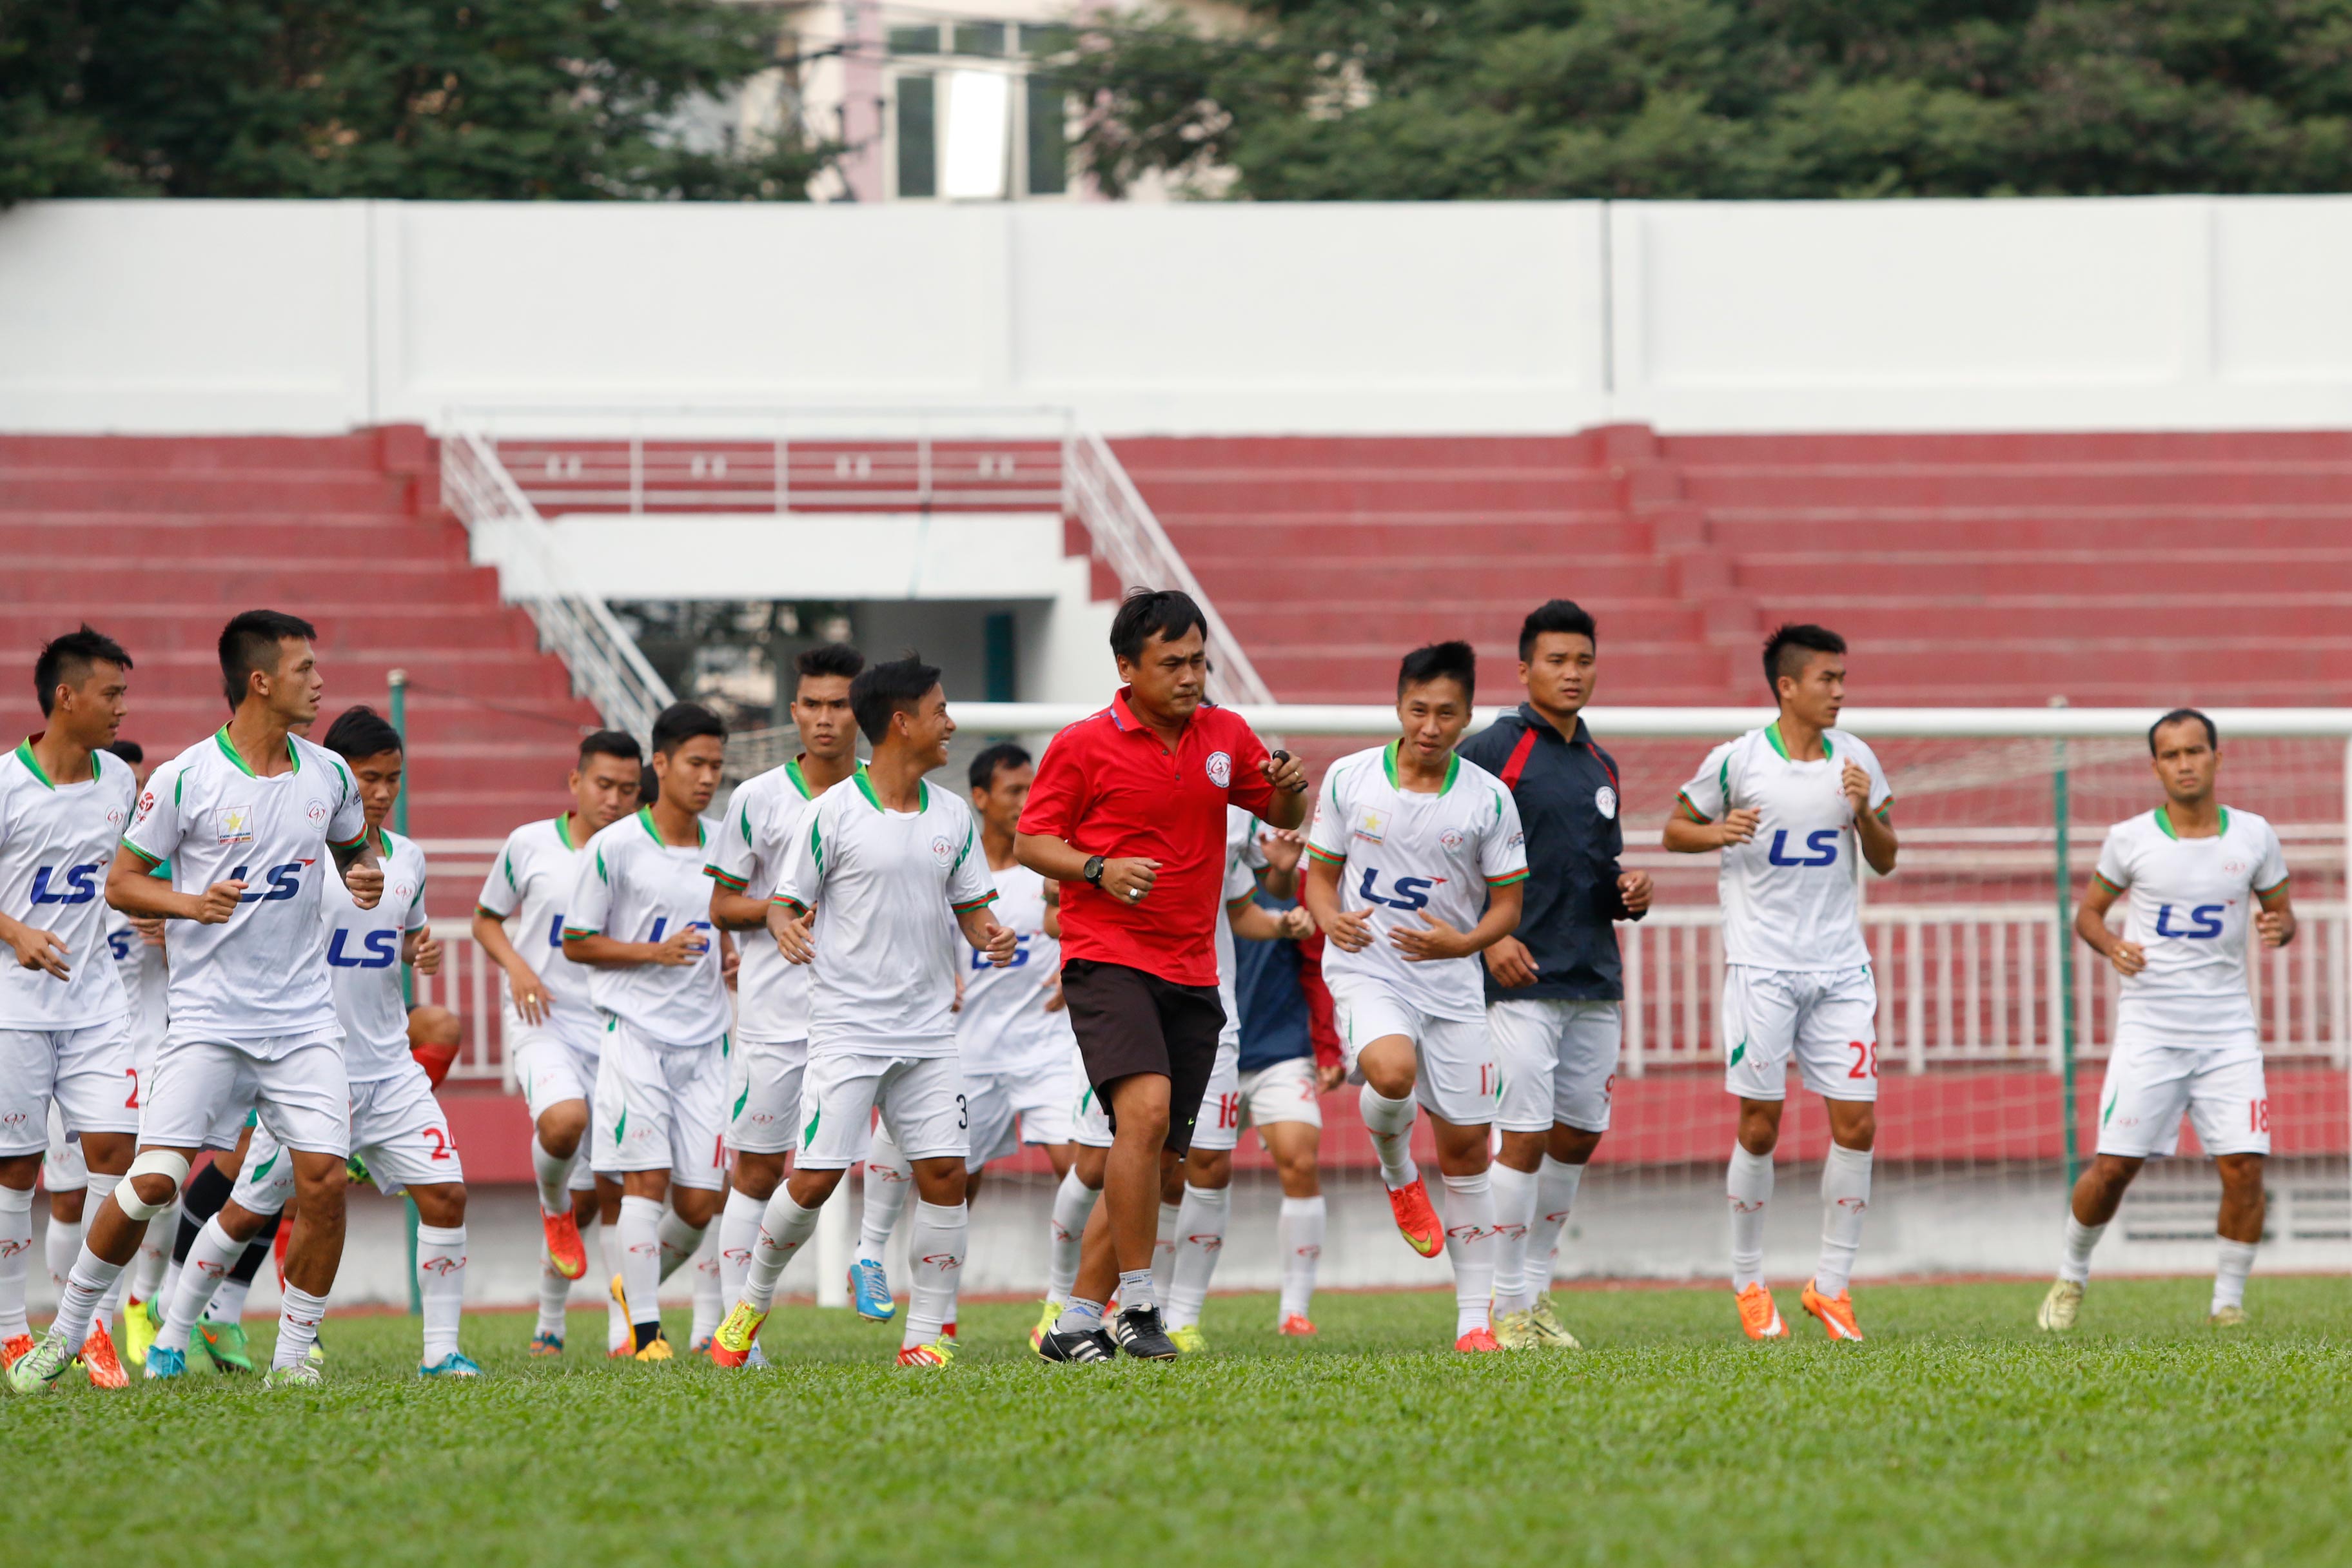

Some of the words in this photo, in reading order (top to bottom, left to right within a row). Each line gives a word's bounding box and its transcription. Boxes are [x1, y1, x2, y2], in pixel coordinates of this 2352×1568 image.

[1769, 830, 1839, 866] LS
[30, 865, 99, 905] LS
[230, 863, 302, 903] LS
[1360, 867, 1433, 911] LS
[549, 915, 565, 947] L
[2156, 905, 2225, 939] LS
[107, 930, 133, 959] S
[327, 928, 397, 968] LS
[956, 1094, 968, 1130] 3
[1219, 1092, 1238, 1128] 16
[2250, 1099, 2269, 1133] 18
